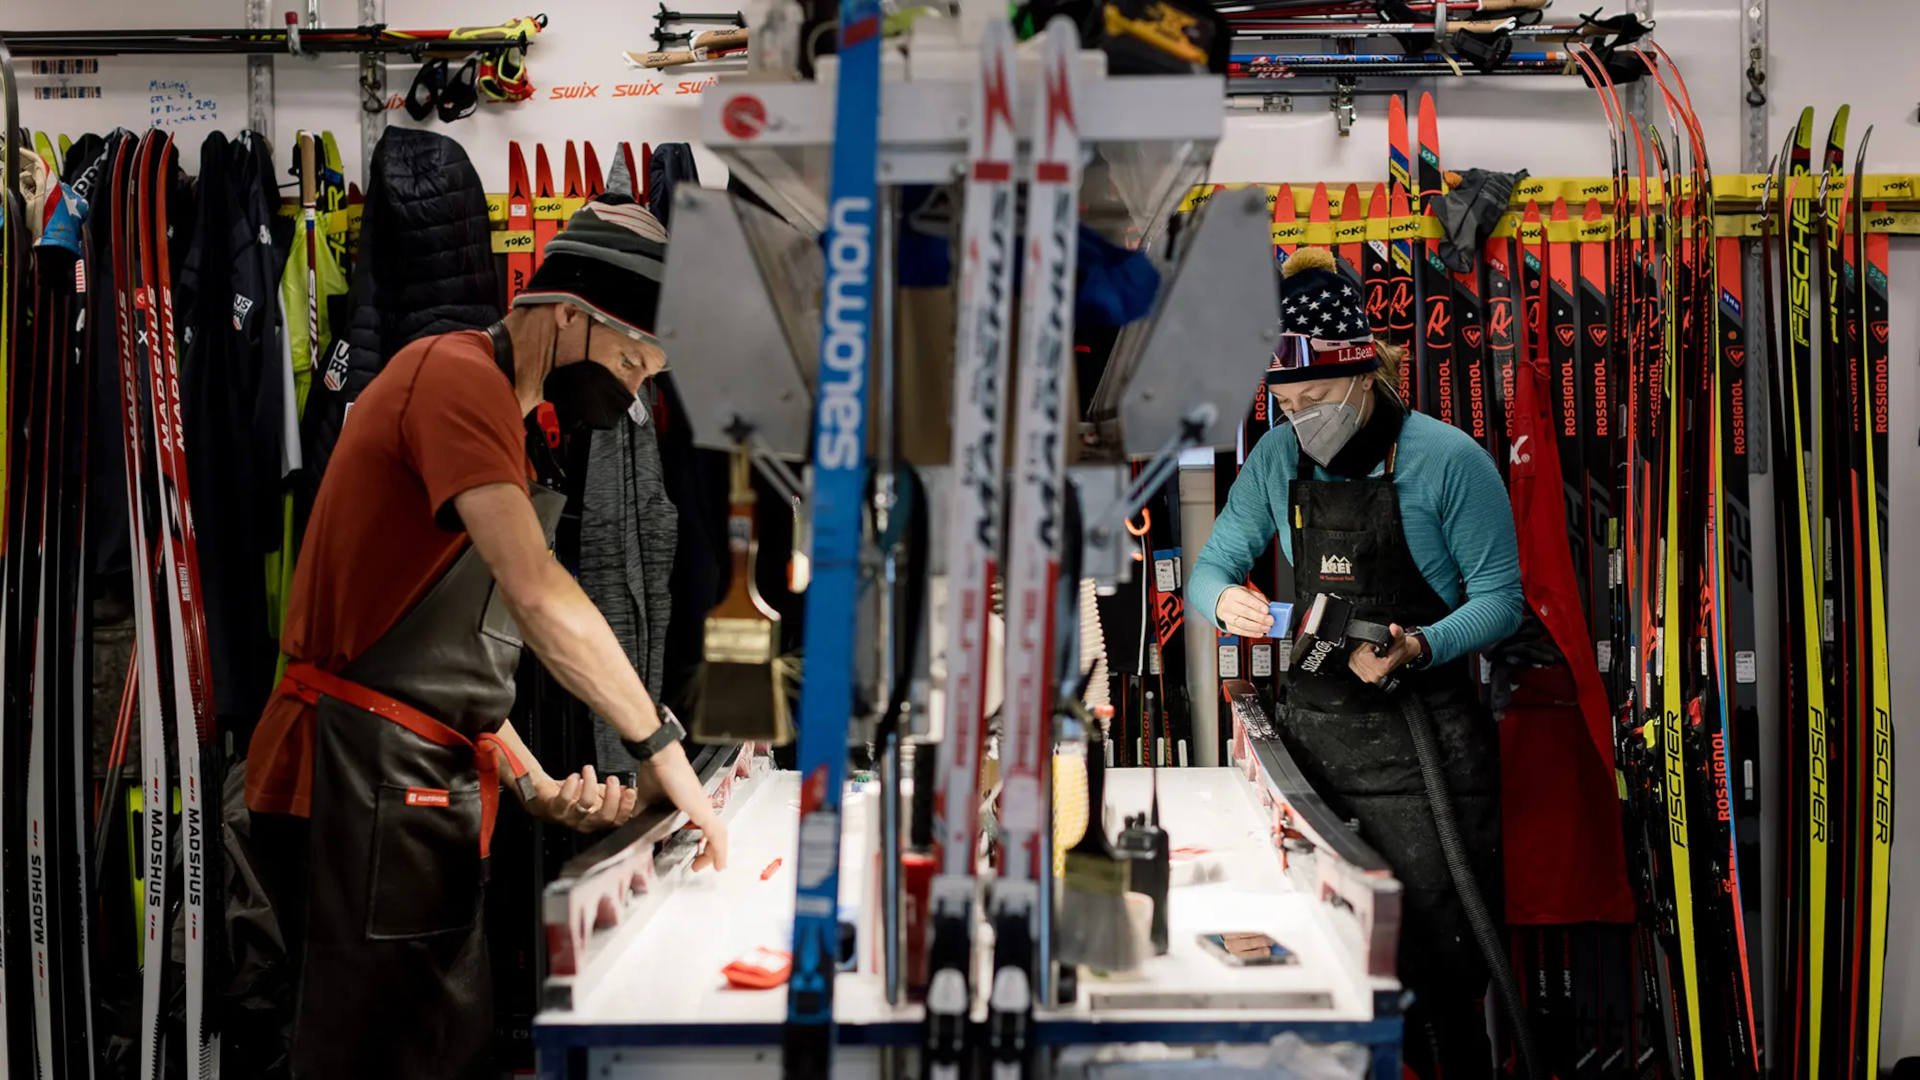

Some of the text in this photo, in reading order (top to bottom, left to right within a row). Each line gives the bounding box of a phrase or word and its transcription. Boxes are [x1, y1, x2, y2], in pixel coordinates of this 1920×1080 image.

[549, 82, 600, 100] swix
[612, 79, 664, 97] swix
[1517, 185, 1544, 195] TOKO
[1582, 184, 1609, 195] TOKO
[1870, 217, 1895, 227] TOKO
[505, 236, 532, 248] TOKO
[1580, 226, 1609, 236] TOKO
[147, 285, 171, 452] MADSHUS
[163, 286, 185, 452] MADSHUS
[1439, 358, 1452, 424] OSSIGNOL
[1469, 359, 1484, 437] ROSSIGNOL
[1561, 358, 1576, 437] ROSSIGNOL
[1594, 358, 1609, 437] ROSSIGNOL
[1875, 354, 1888, 434] ROSSIGNOL
[1731, 378, 1745, 456] ROSSIGNOL
[1666, 709, 1689, 849] FISCHER
[1711, 728, 1732, 822] ROSSIGNOL
[1810, 706, 1826, 844] FISCHER
[1874, 707, 1889, 845] FISCHER
[149, 808, 164, 908] MADSHUS
[188, 808, 202, 907] MADSHUS
[30, 853, 45, 944] MADSHUS
